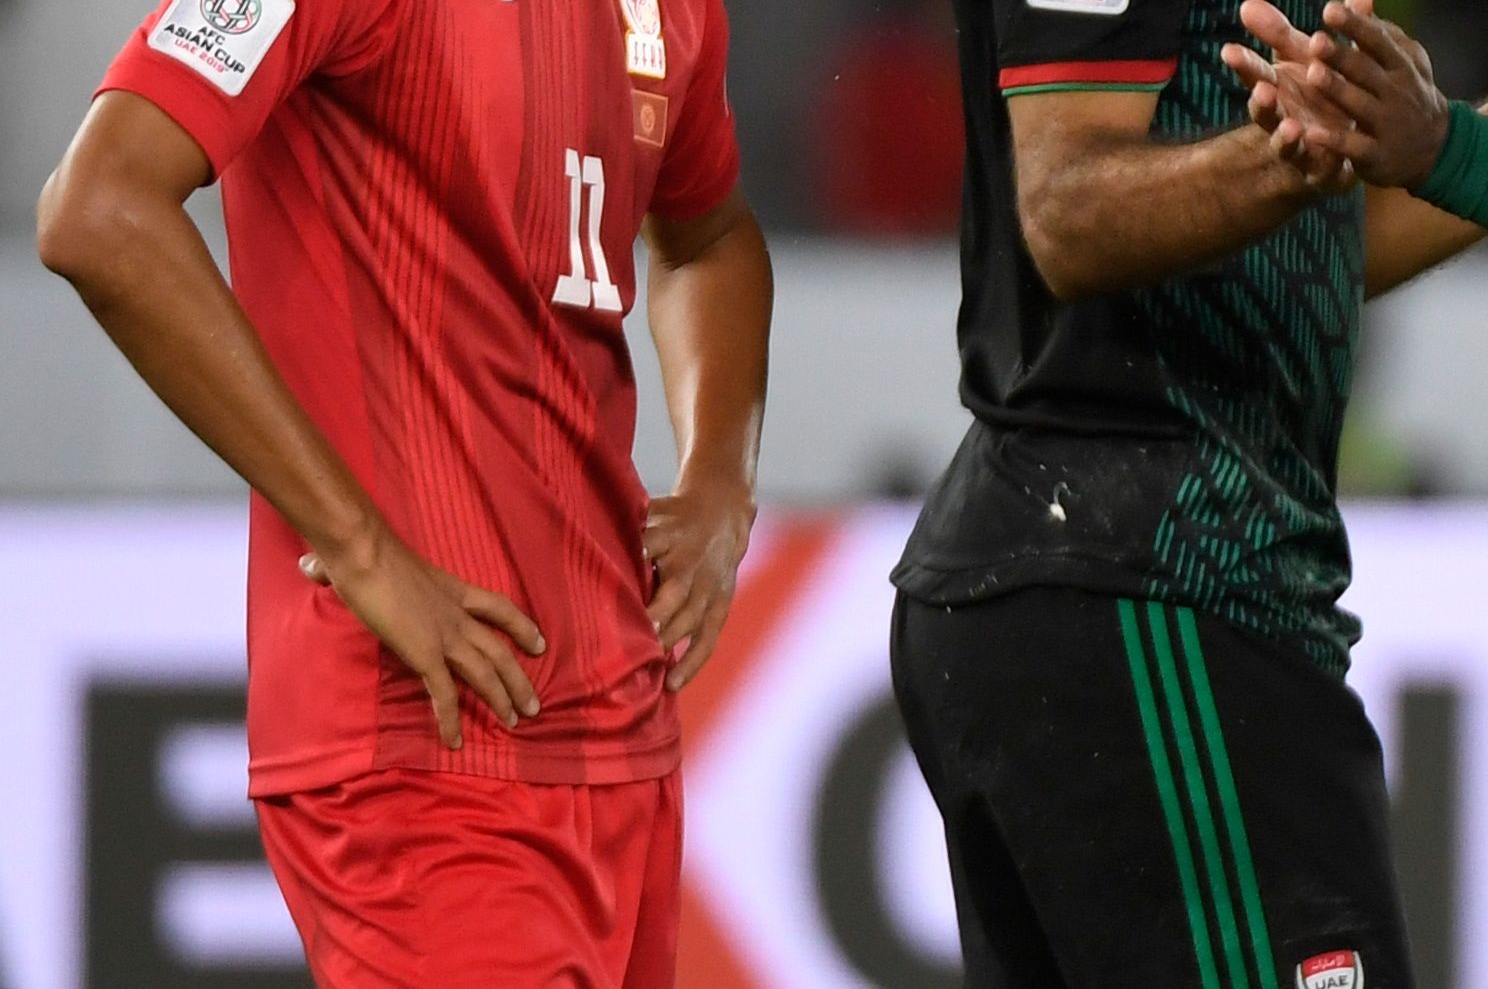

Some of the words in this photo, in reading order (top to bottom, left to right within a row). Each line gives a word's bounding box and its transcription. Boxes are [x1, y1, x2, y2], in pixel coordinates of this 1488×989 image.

[198, 25, 226, 46] AFC
[163, 23, 214, 53] ASIAN
[213, 47, 246, 75] CUP
[174, 39, 197, 55] UAE
[551, 147, 623, 311] 11
[1315, 974, 1350, 989] UAE
